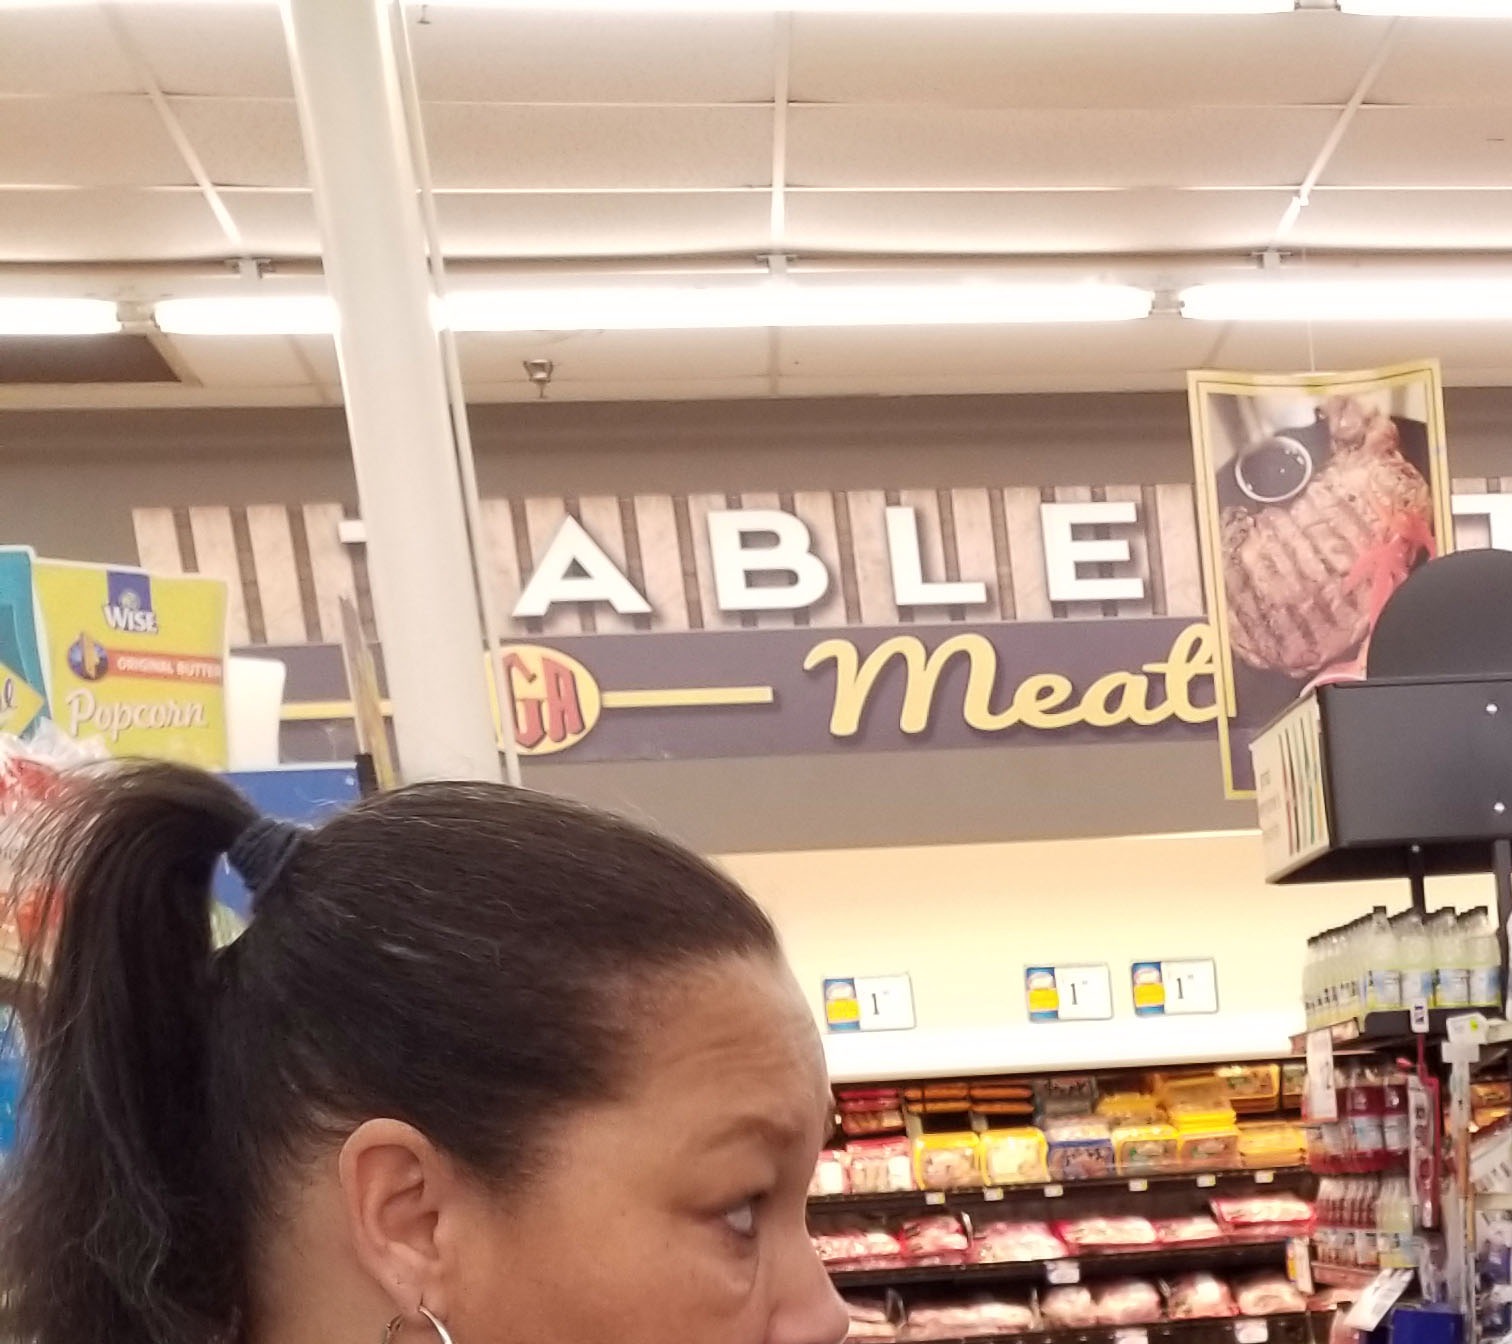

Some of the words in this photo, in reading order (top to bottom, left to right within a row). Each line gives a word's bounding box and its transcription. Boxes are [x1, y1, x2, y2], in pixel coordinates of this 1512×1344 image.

[103, 603, 159, 635] WISE
[116, 656, 174, 675] ORIGINAL
[65, 686, 209, 743] Popcorn
